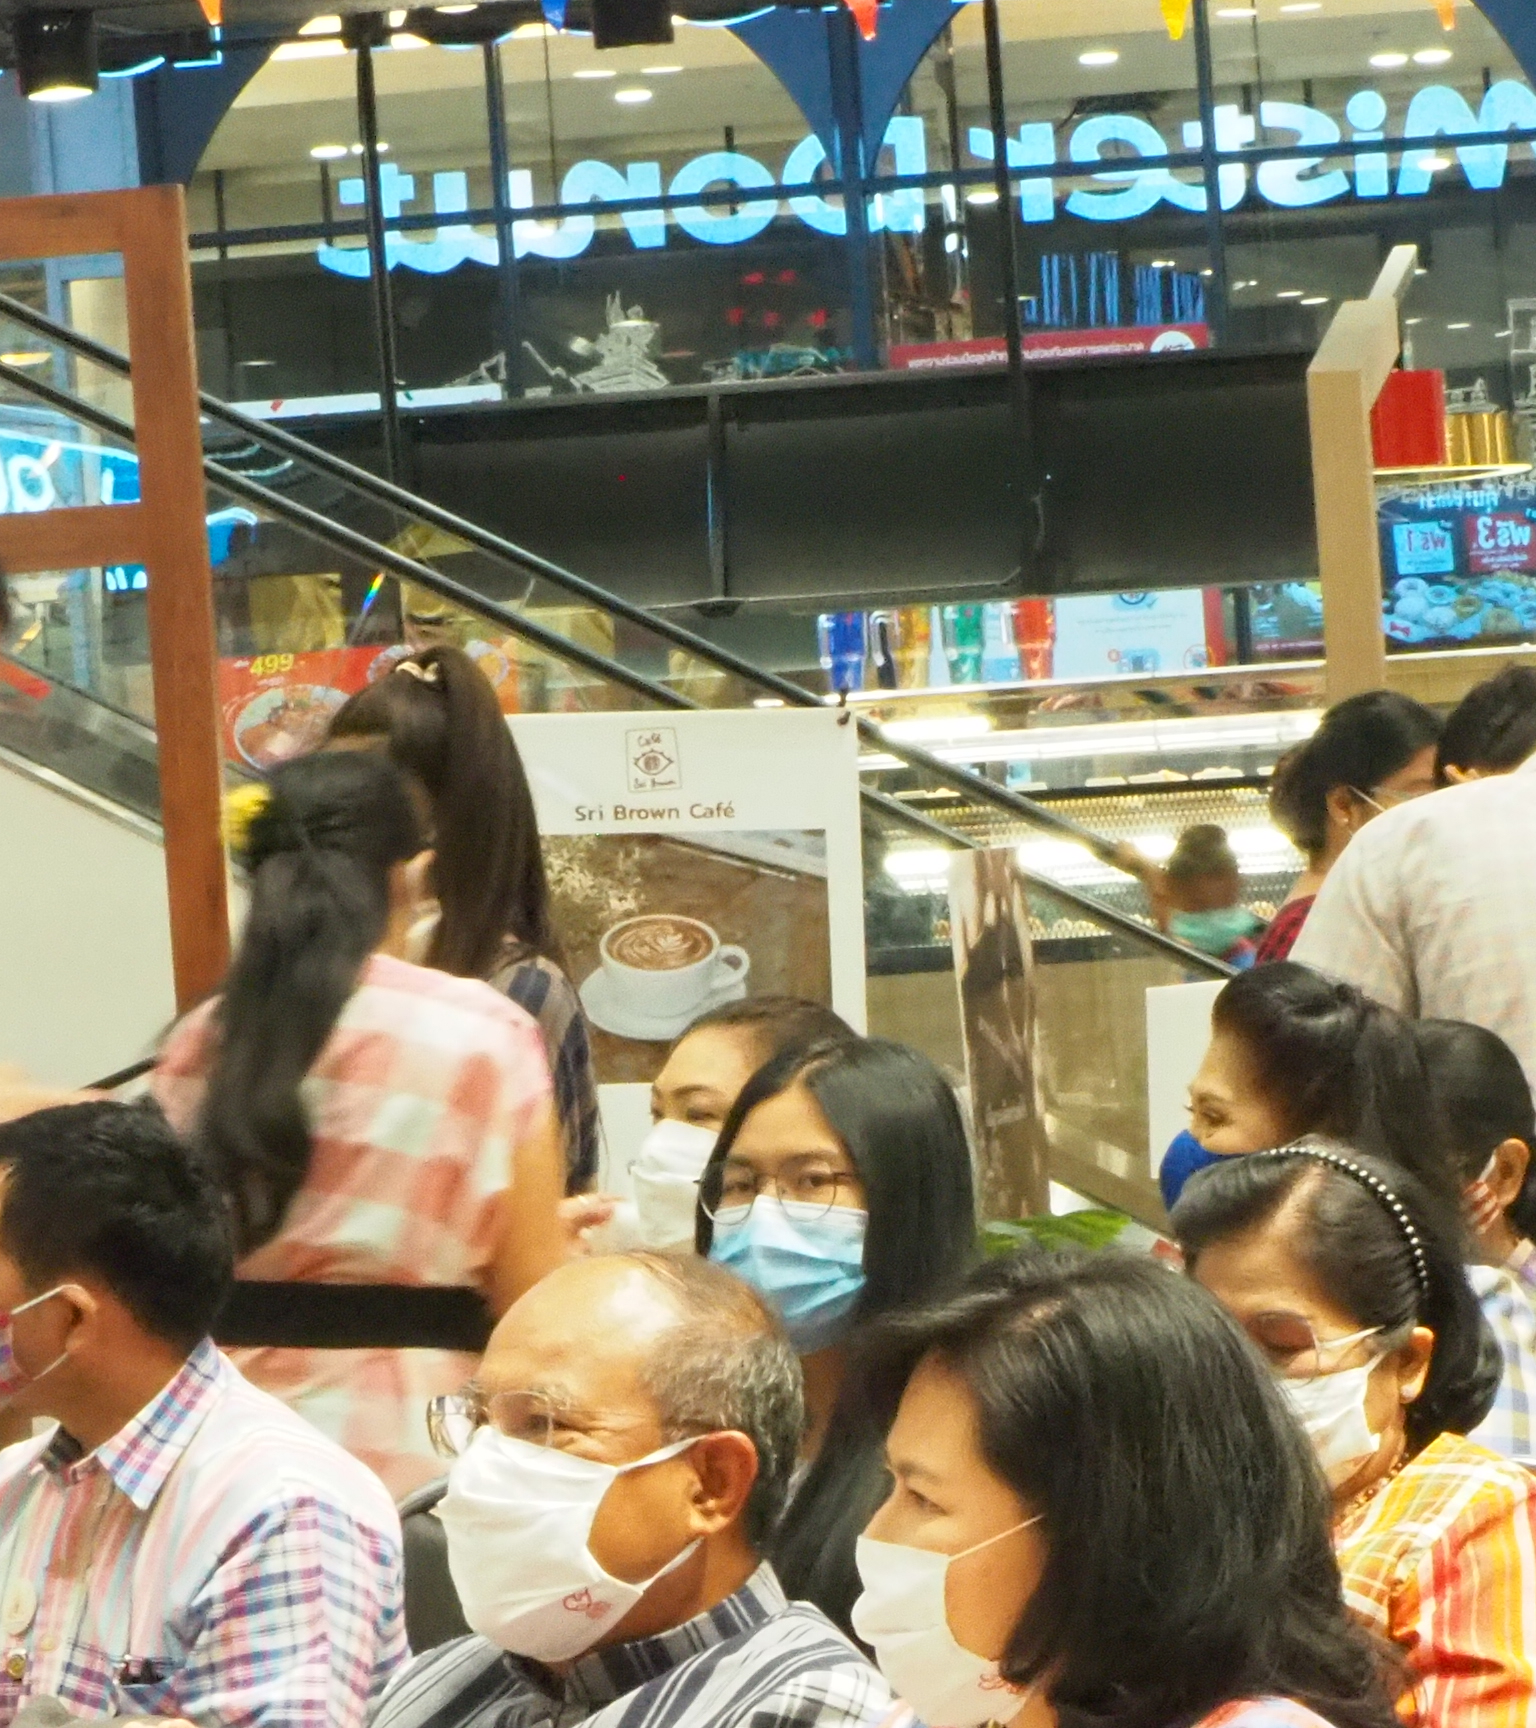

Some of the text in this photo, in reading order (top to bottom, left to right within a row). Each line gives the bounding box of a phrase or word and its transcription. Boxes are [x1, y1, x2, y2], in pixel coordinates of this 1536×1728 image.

[250, 653, 295, 676] 499
[575, 800, 736, 821] Sri Brown Café
